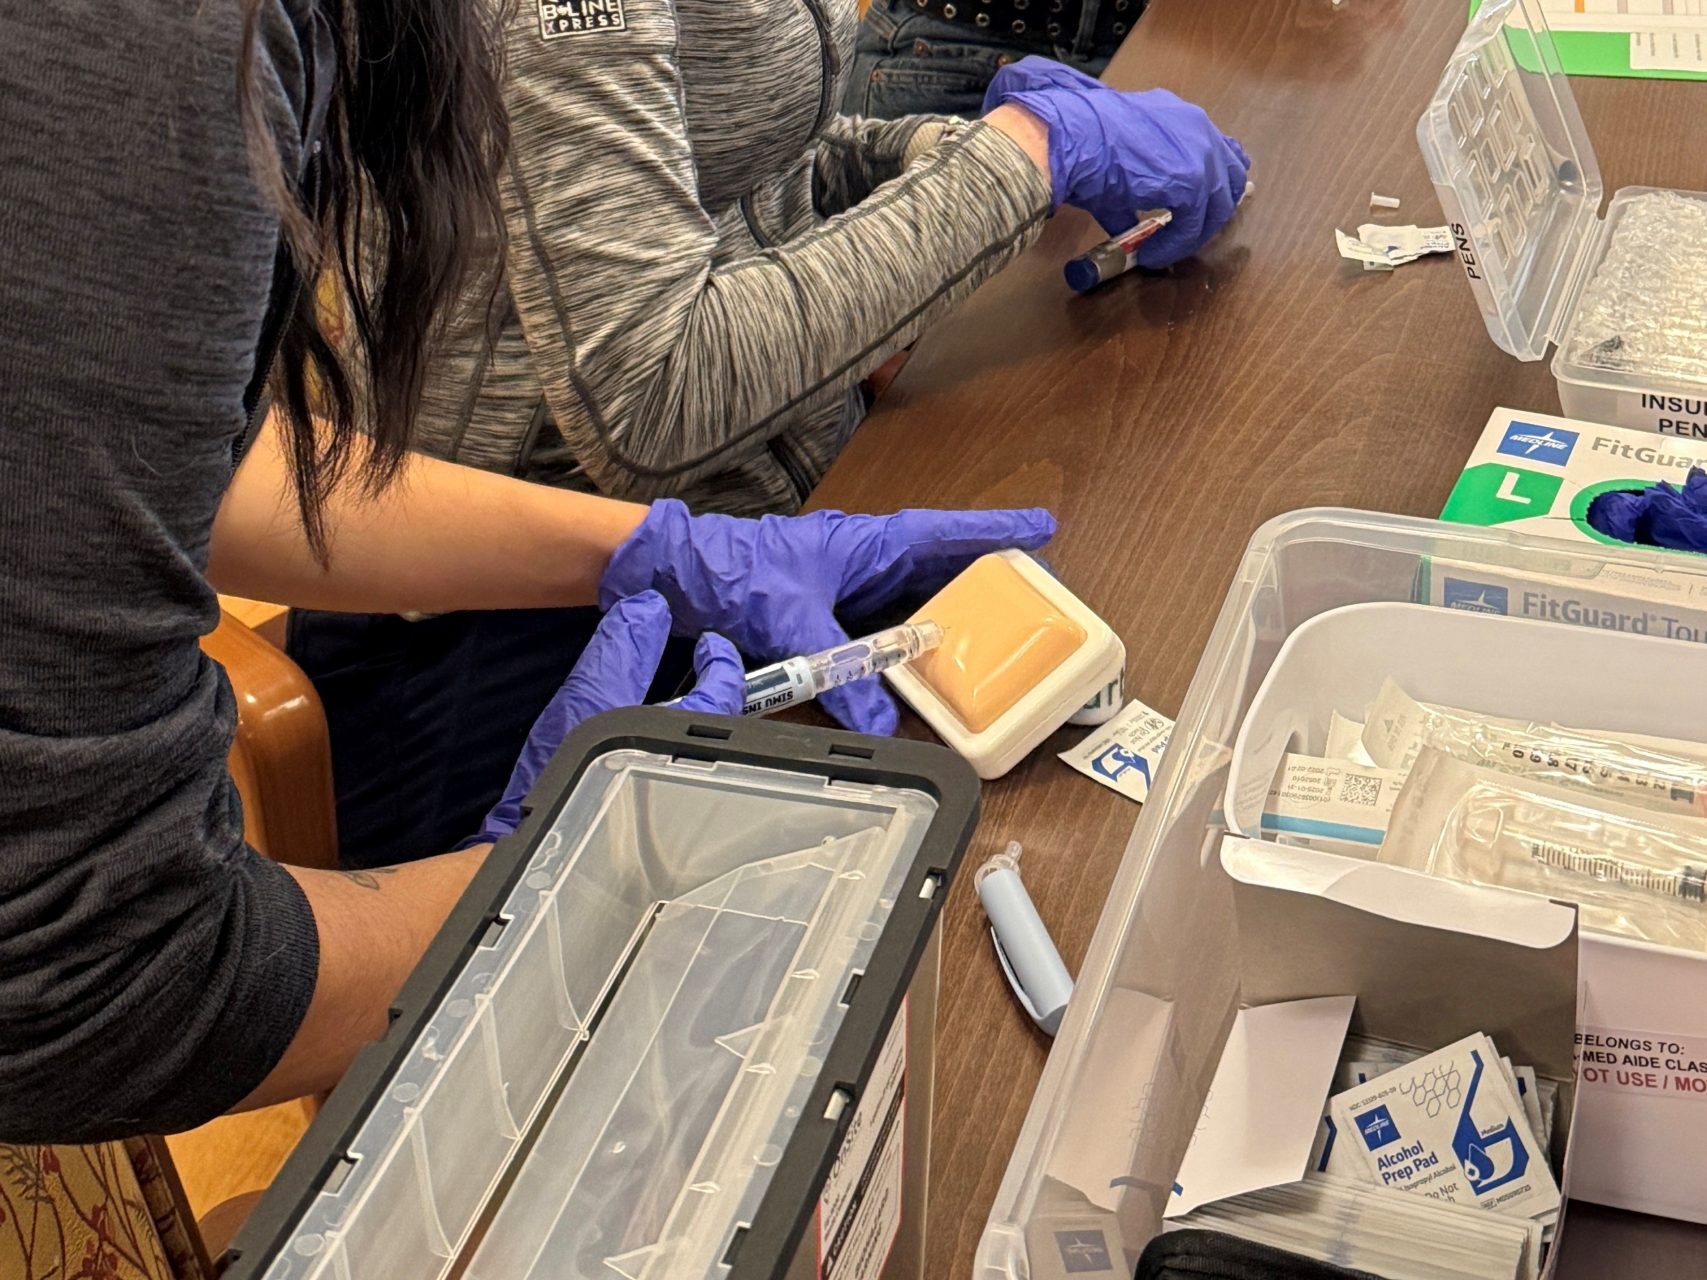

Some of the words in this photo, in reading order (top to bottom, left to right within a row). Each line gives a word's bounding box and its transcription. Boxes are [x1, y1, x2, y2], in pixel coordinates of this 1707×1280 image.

[545, 13, 620, 34] XPRESS
[1451, 222, 1482, 280] PENS
[1509, 433, 1569, 451] MEDLINE
[1496, 471, 1532, 505] L
[764, 690, 794, 708] SIMU
[1574, 1033, 1652, 1052] BELONGS
[1658, 1041, 1685, 1055] TO:
[1622, 1054, 1661, 1069] AIDE
[1578, 1067, 1609, 1084] OT
[1616, 1070, 1658, 1089] USE
[1663, 1075, 1669, 1090] /
[1377, 1139, 1424, 1170] Alcohol
[1382, 1164, 1413, 1185] Prep
[1413, 1151, 1439, 1171] Pad
[1439, 1181, 1459, 1196] Not
